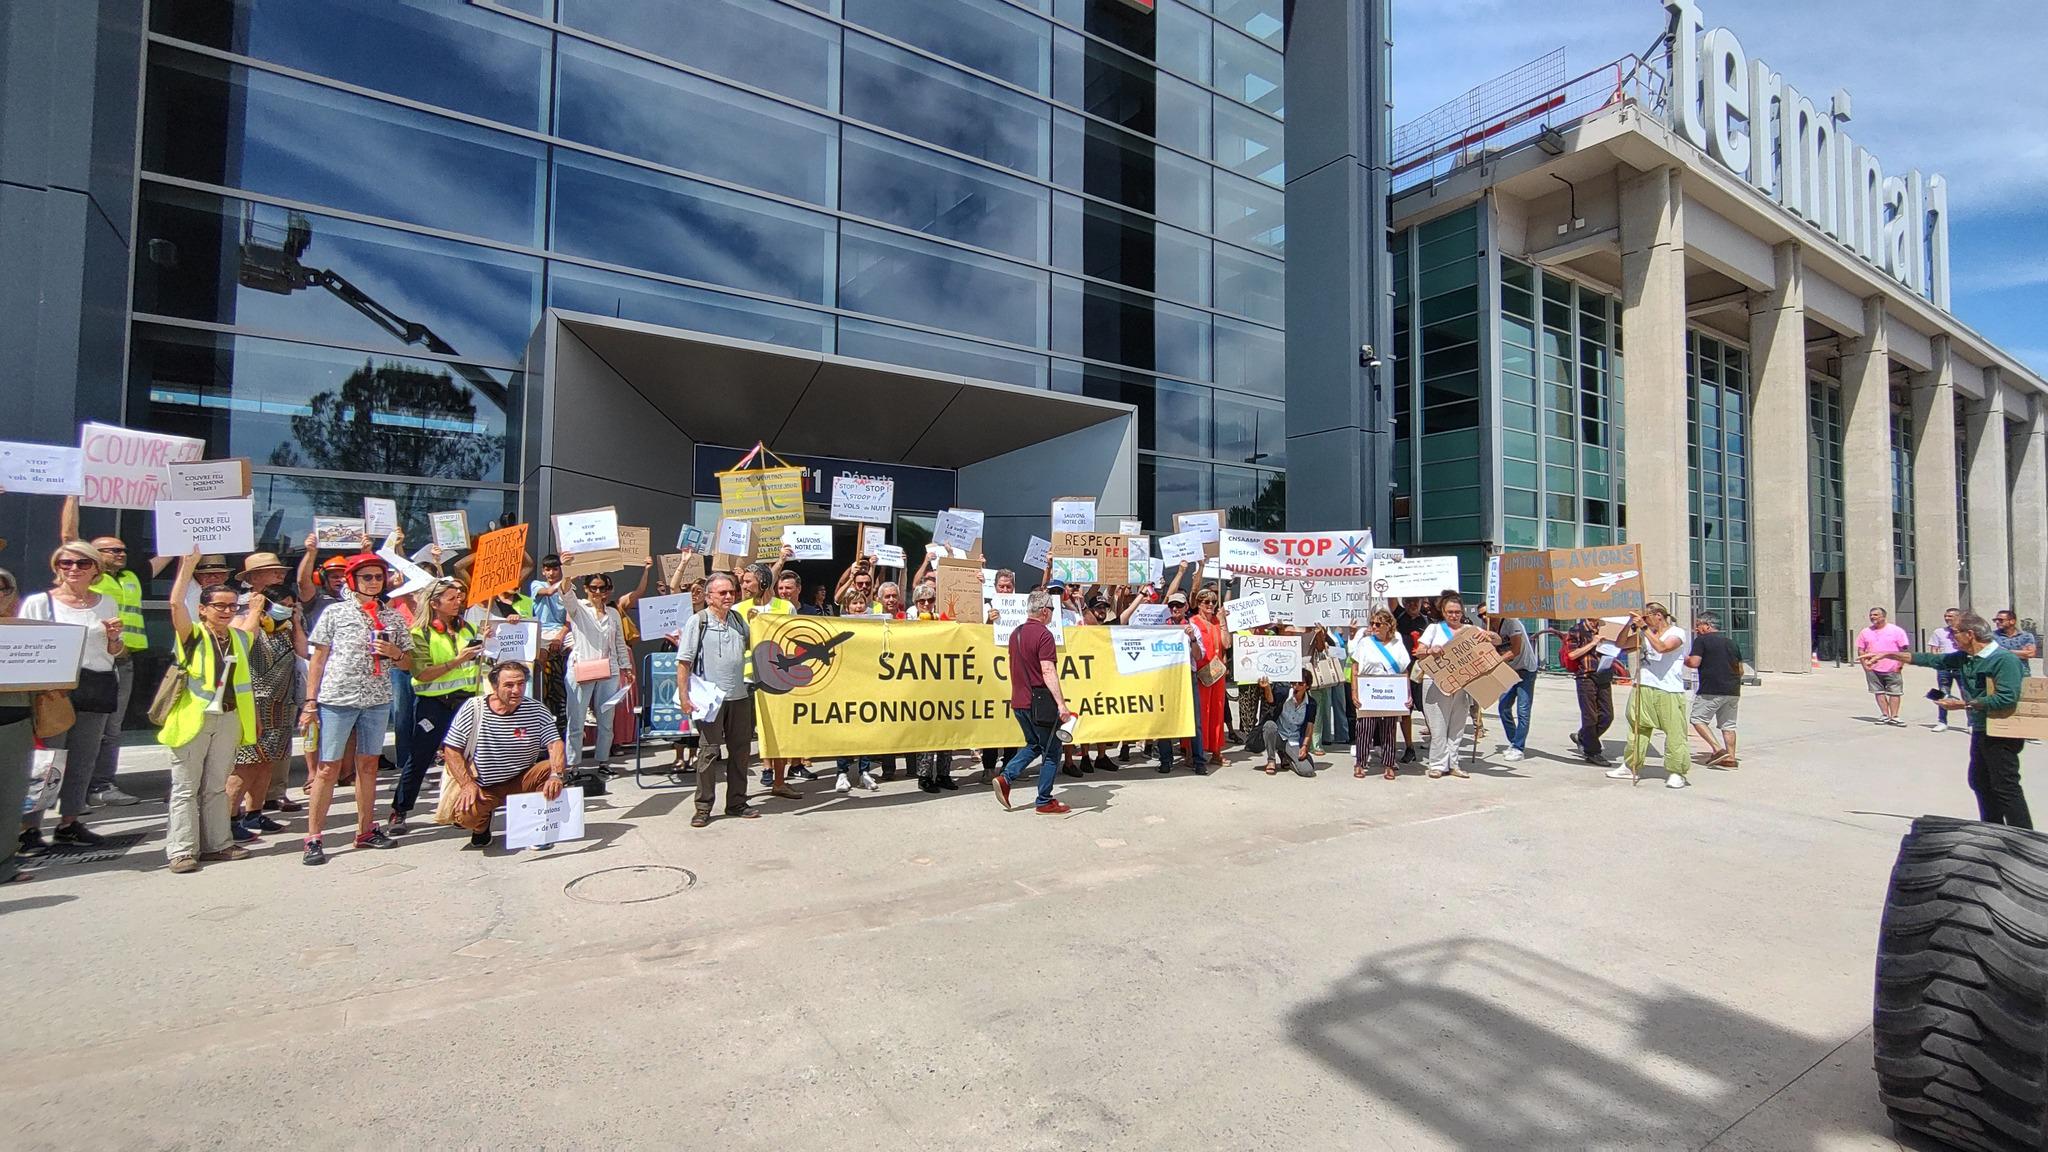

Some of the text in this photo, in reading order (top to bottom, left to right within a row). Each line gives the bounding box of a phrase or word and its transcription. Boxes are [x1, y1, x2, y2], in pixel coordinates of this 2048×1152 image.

[1663, 0, 1951, 317] terminal 1
[86, 434, 168, 467] COUVRE
[813, 469, 822, 493] 1
[85, 474, 168, 506] DORMONS
[843, 502, 860, 510] VOLS
[192, 525, 231, 533] DORMONS
[193, 534, 217, 542] MIEUX
[1065, 533, 1121, 546] RESPECT
[1083, 548, 1098, 556] DU
[1263, 538, 1333, 556] STOP
[1285, 558, 1309, 566] AUX
[1504, 555, 1546, 572] LIMITONS
[1568, 549, 1636, 569] AVIONS
[1225, 563, 1302, 577] NUISANCES
[1306, 566, 1368, 577] SONORES
[1489, 557, 1498, 611] mistral
[1321, 609, 1331, 619] DE
[1151, 640, 1184, 652] ufcna
[1238, 635, 1298, 648] Pas d'avions
[878, 646, 1095, 685] SANTÉ, CAT
[1425, 652, 1452, 675] LES
[1446, 652, 1475, 674] LA NUIT
[792, 700, 965, 725] PLAFONNONS
[971, 699, 995, 719] LE
[1079, 692, 1154, 716] AÉRIEN
[1160, 694, 1165, 712] !
[537, 806, 560, 816] D'avions
[541, 823, 549, 832] de
[549, 822, 559, 831] VIE
